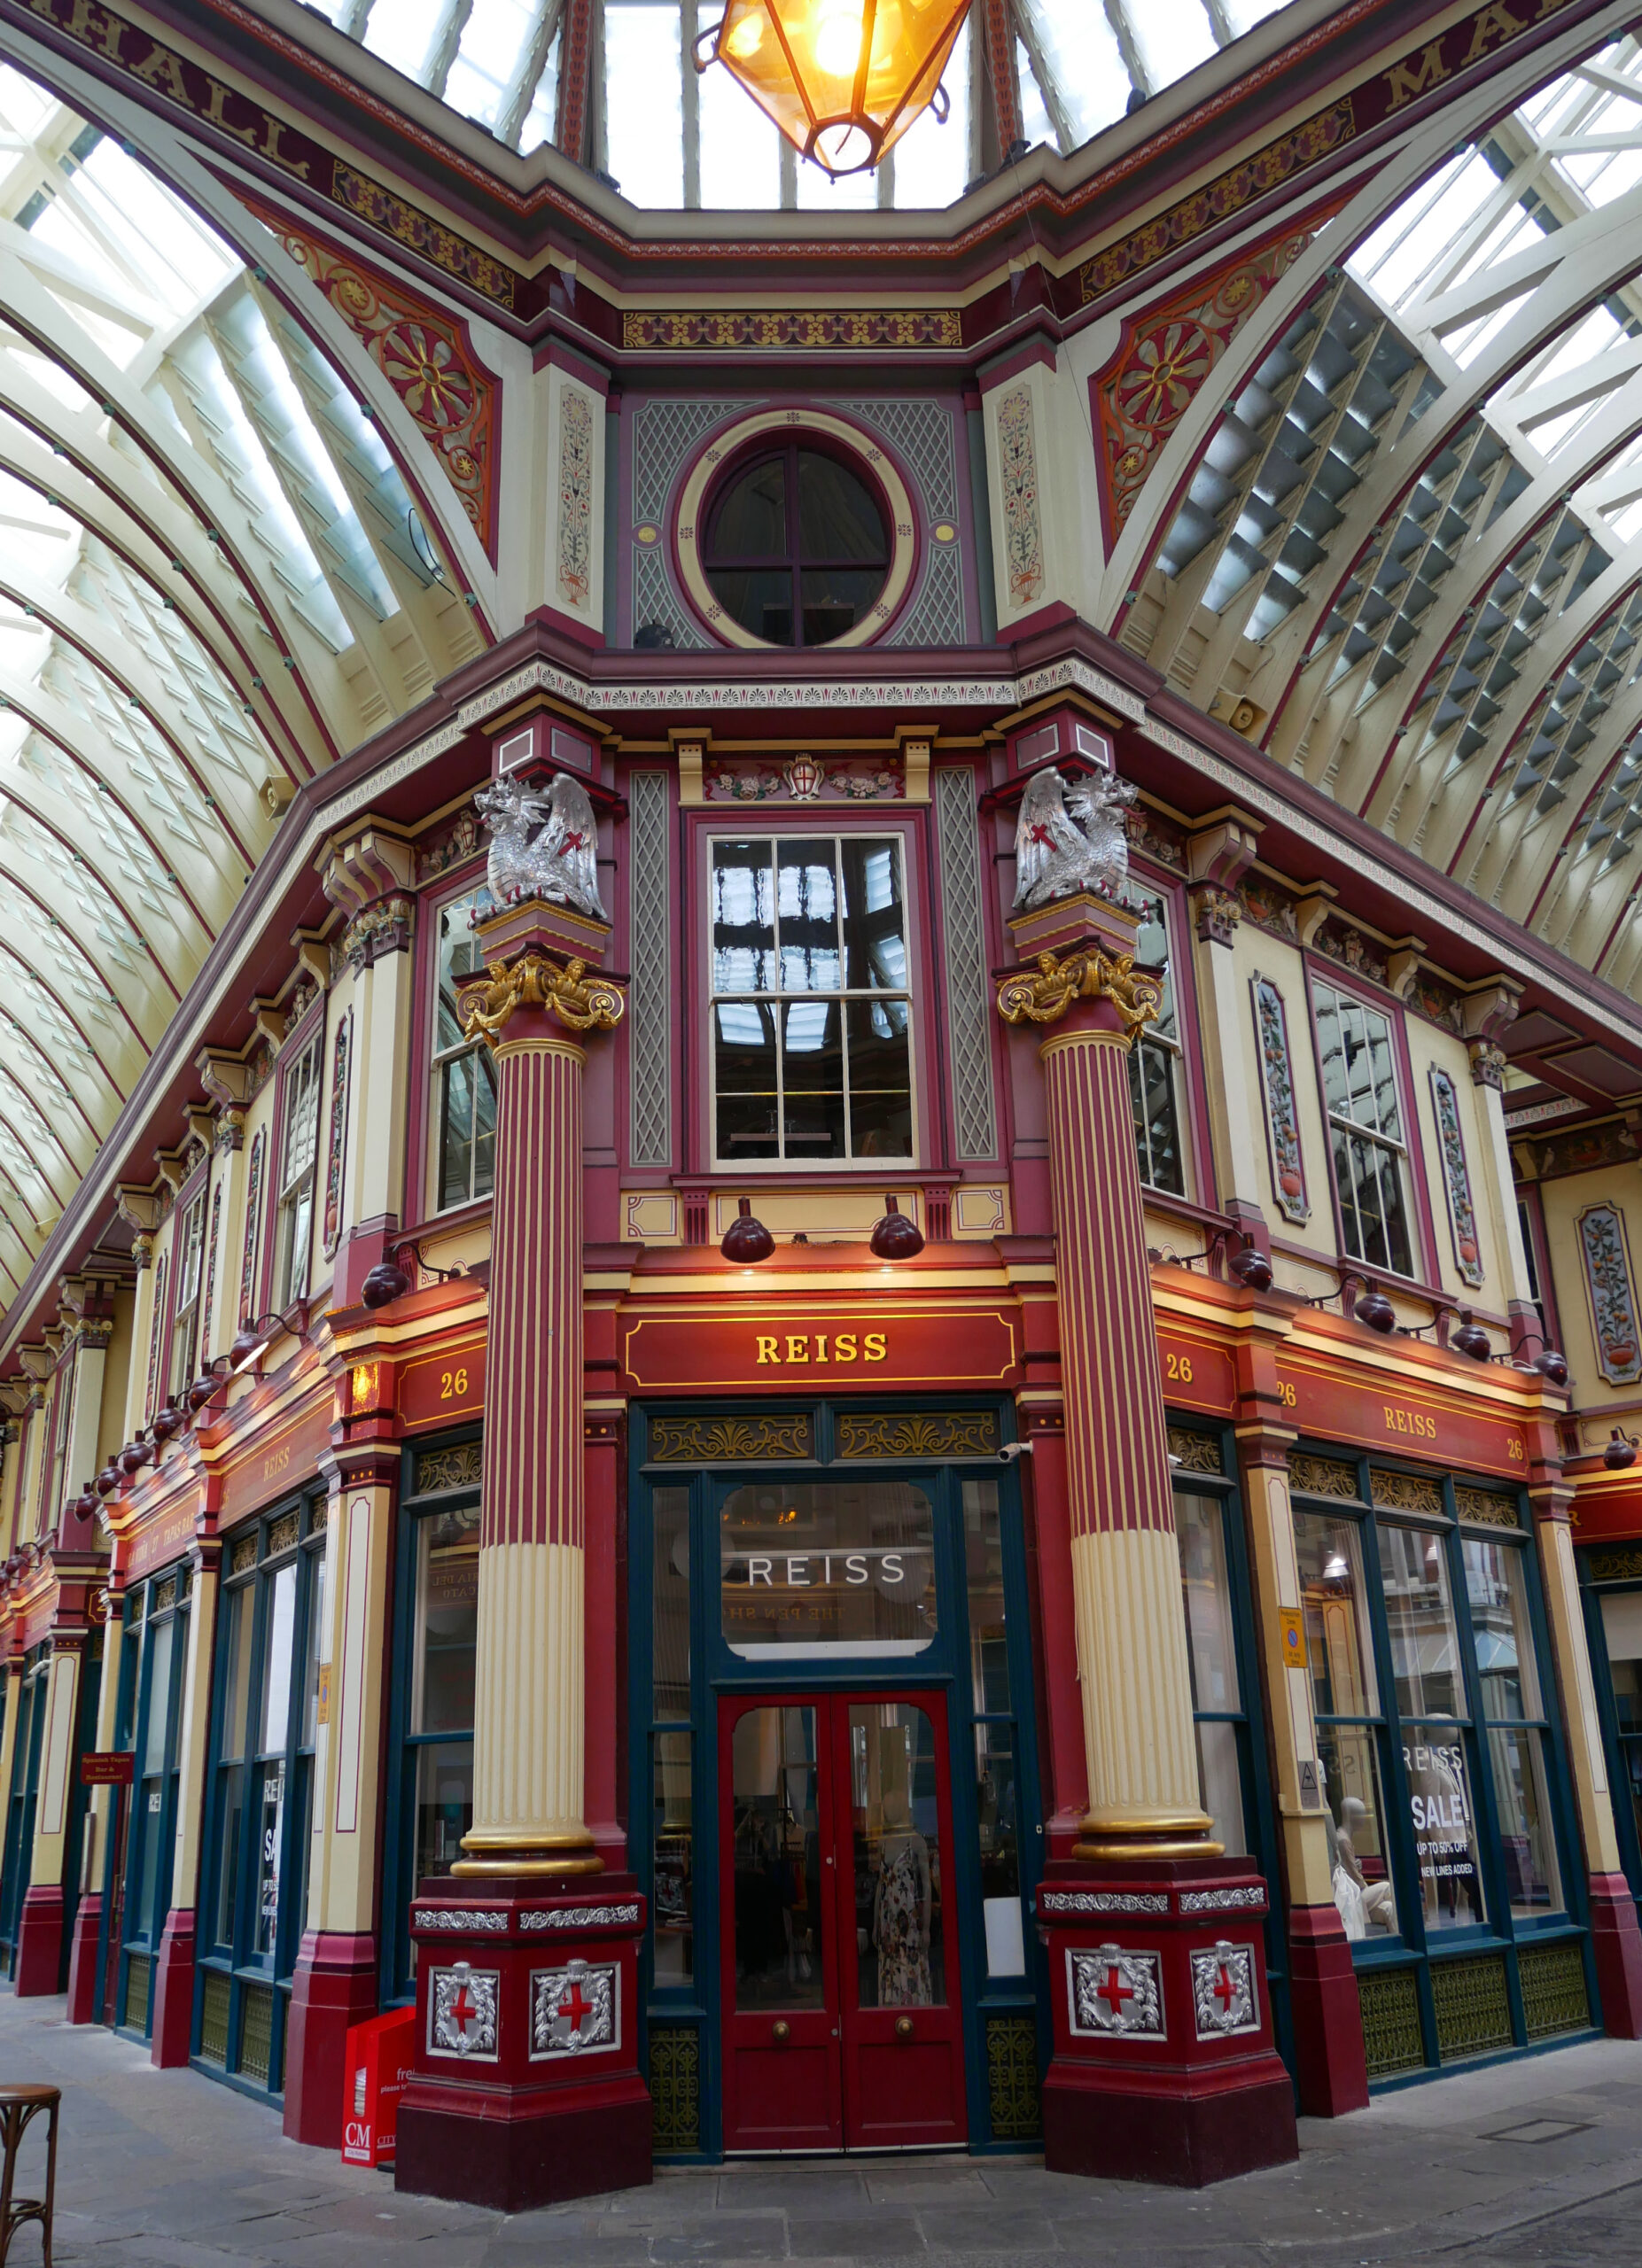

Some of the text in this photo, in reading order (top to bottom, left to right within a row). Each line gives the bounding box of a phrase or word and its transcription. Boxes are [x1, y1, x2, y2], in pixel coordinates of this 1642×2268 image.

[756, 1333, 887, 1364] REISS
[1166, 1353, 1194, 1383] 26
[440, 1368, 469, 1400] 26
[1383, 1406, 1436, 1439] REISS
[1507, 1438, 1523, 1461] 26
[263, 1447, 290, 1482] REISS
[749, 1554, 905, 1586] REISS
[1403, 1746, 1461, 1771] REISS
[1411, 1794, 1465, 1830] SALE
[1417, 1839, 1468, 1856] UP TO 50% OFF
[1421, 1862, 1473, 1877] NEW LINES ADDED
[396, 2067, 415, 2081] fre
[346, 2122, 371, 2148] CM
[377, 2134, 396, 2145] CITY
